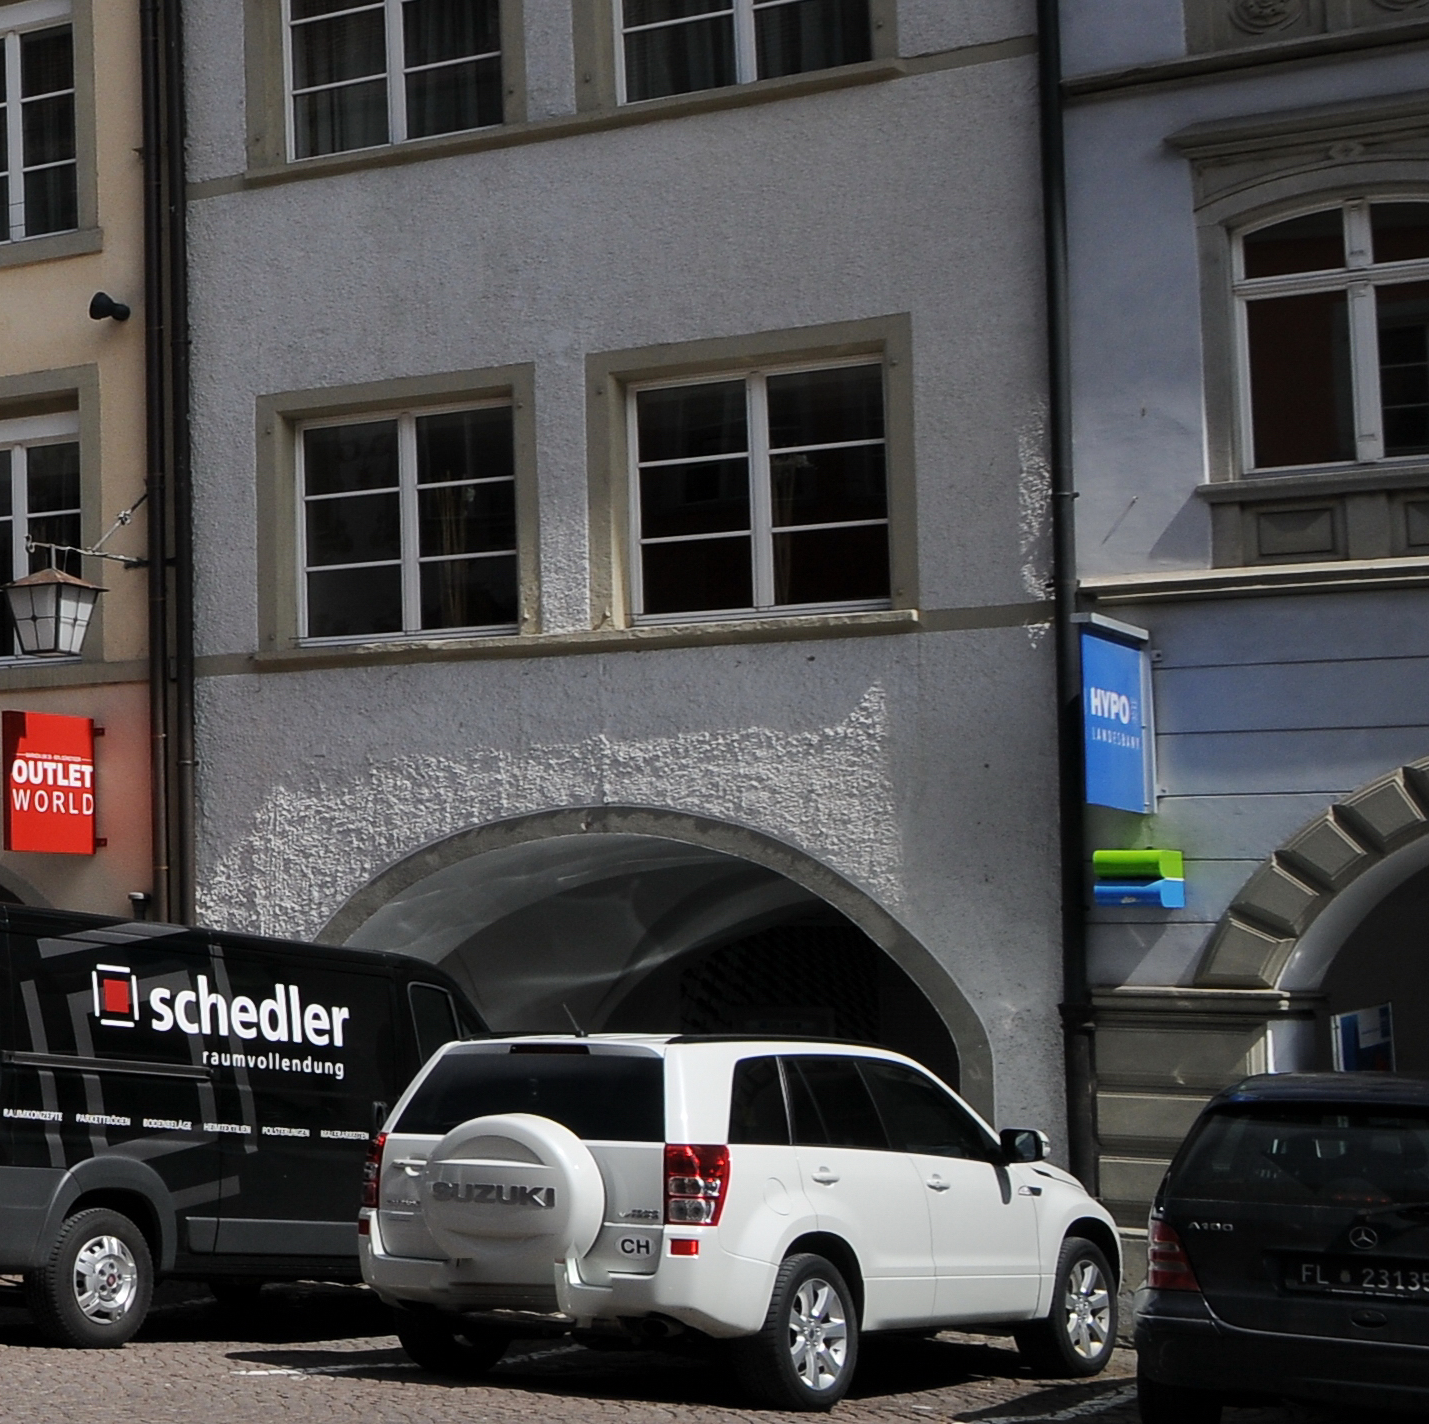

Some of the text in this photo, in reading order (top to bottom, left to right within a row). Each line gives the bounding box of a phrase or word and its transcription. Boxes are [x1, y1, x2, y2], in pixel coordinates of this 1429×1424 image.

[1090, 686, 1131, 725] HYPO
[12, 758, 94, 789] OUTLET
[12, 788, 95, 816] WORLD
[149, 974, 350, 1048] schedler
[202, 1050, 345, 1080] raumvollendung
[431, 1181, 556, 1208] SUZUKI
[620, 1238, 650, 1255] CH
[1301, 1263, 1329, 1285] FL
